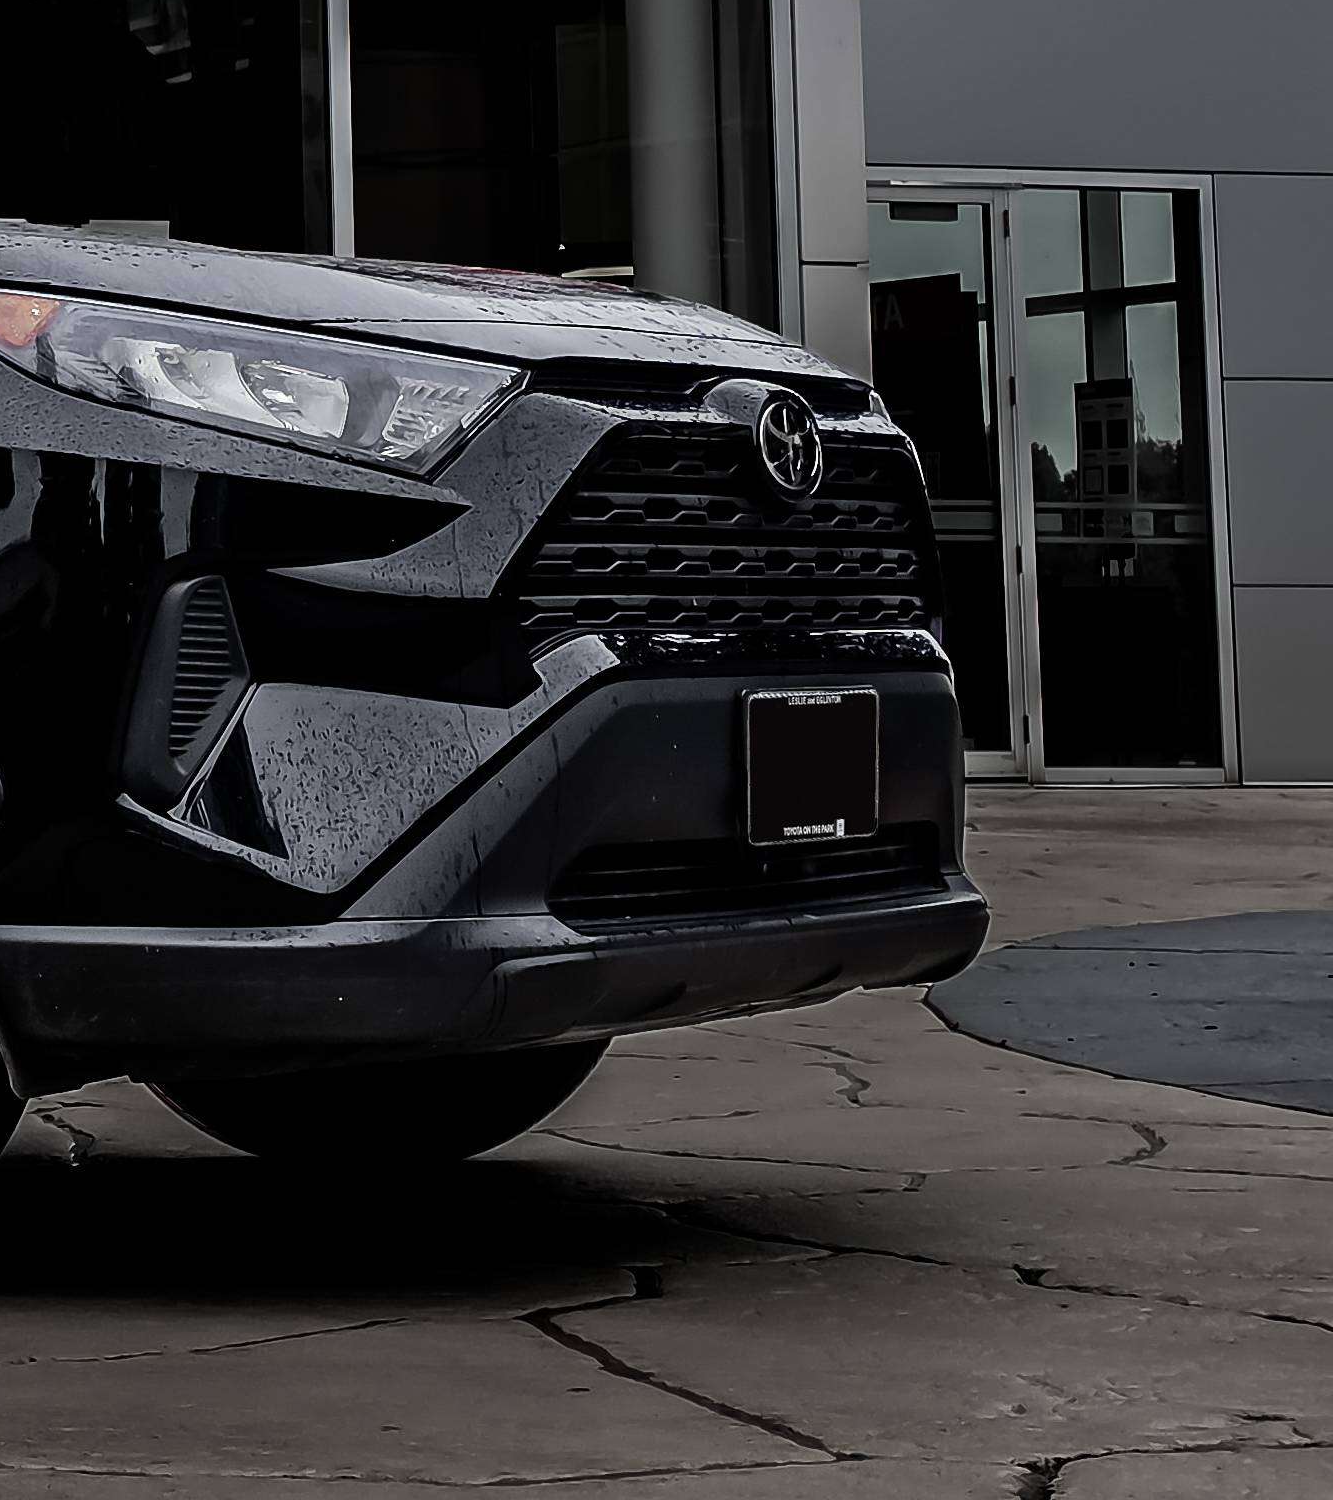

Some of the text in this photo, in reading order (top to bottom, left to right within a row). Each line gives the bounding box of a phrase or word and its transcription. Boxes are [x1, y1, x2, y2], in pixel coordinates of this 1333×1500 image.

[788, 696, 807, 706] LESLIE
[783, 824, 834, 836] TOYOTA ON THE PARK
